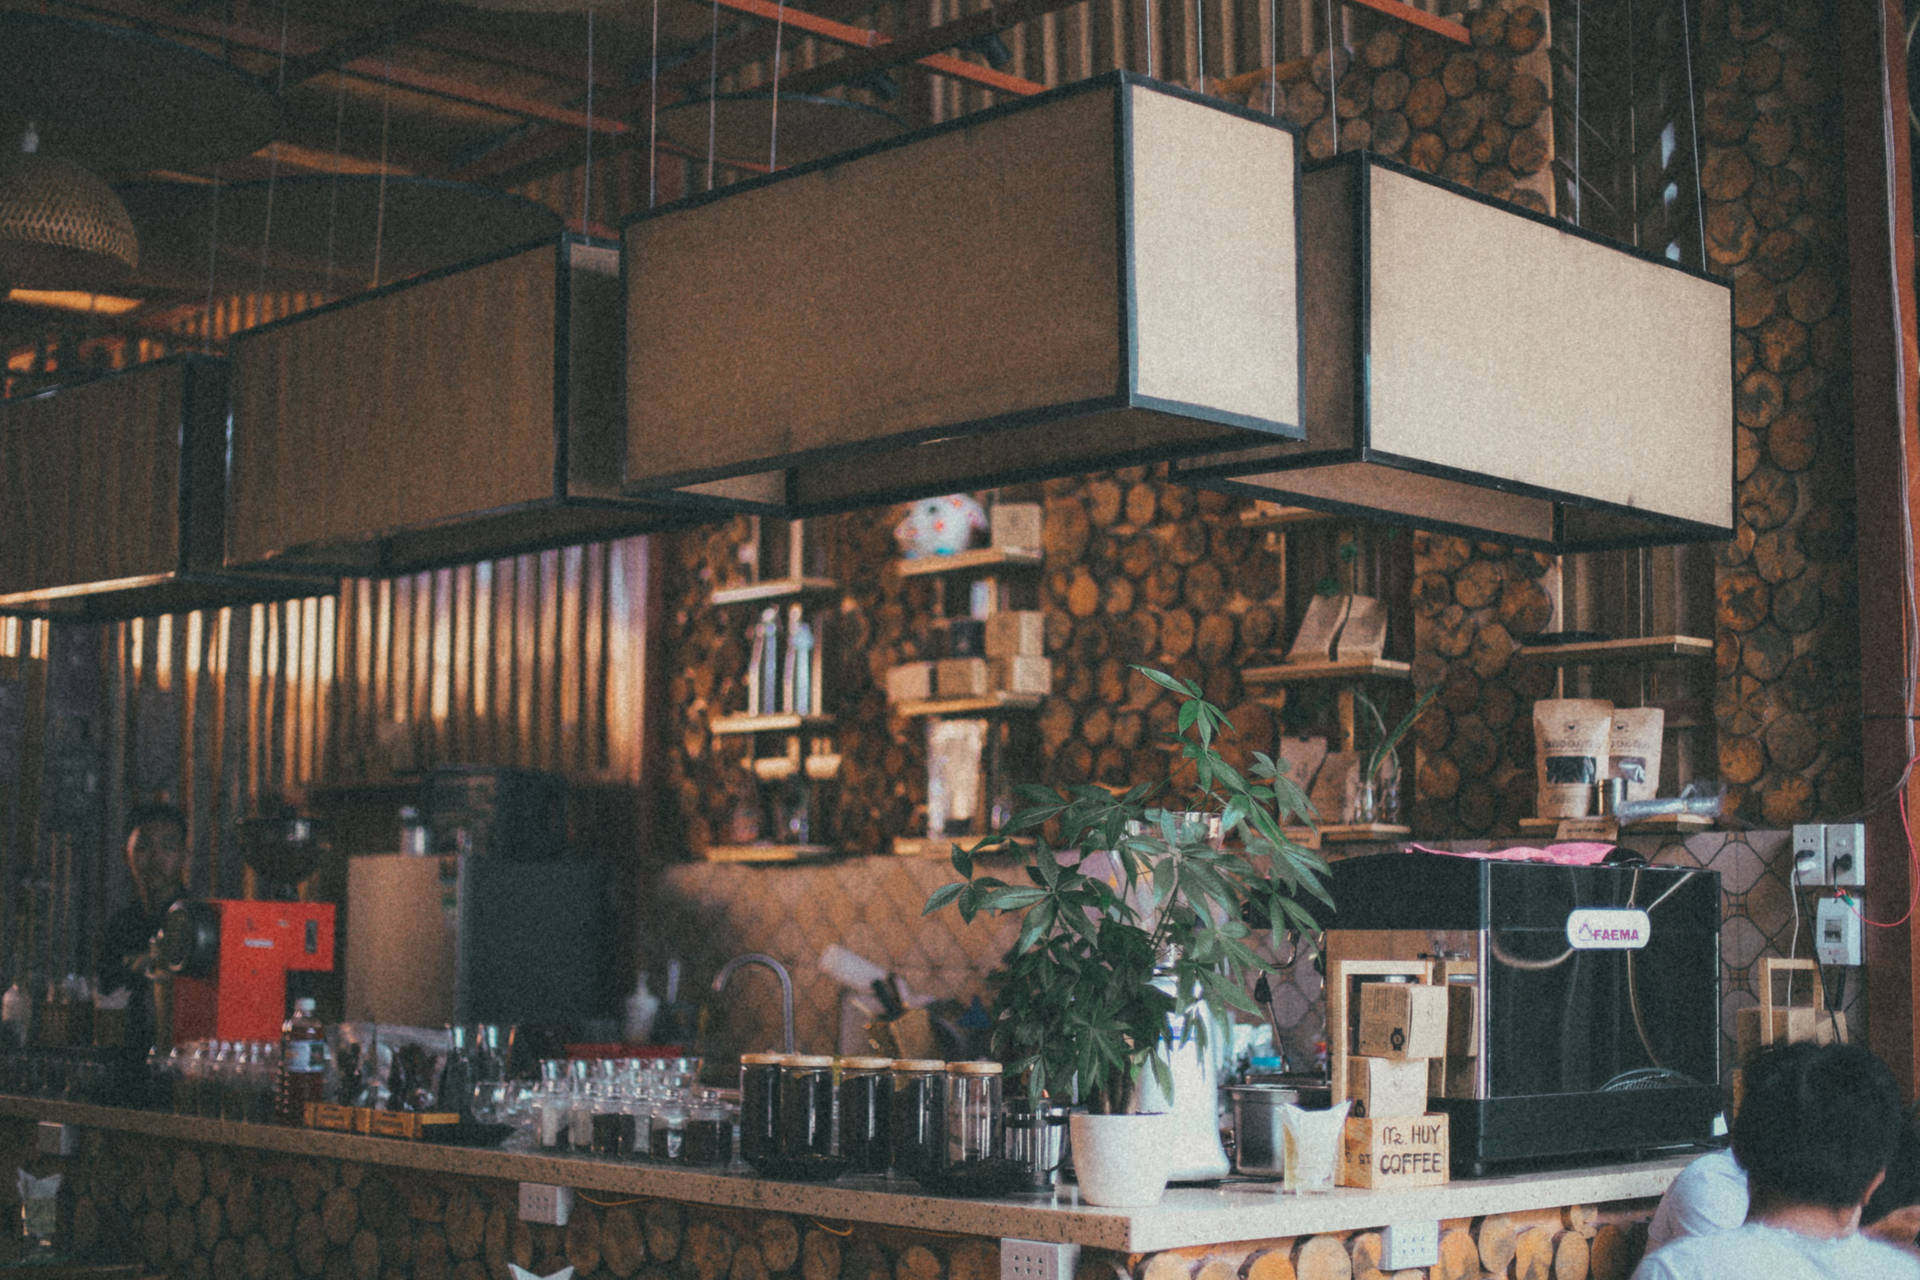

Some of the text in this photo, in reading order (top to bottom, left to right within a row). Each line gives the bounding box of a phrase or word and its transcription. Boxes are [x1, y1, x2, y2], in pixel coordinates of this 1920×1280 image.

[1593, 928, 1639, 941] FAEMA
[1411, 1124, 1440, 1145] HUY
[1380, 1152, 1441, 1175] COFFEE
